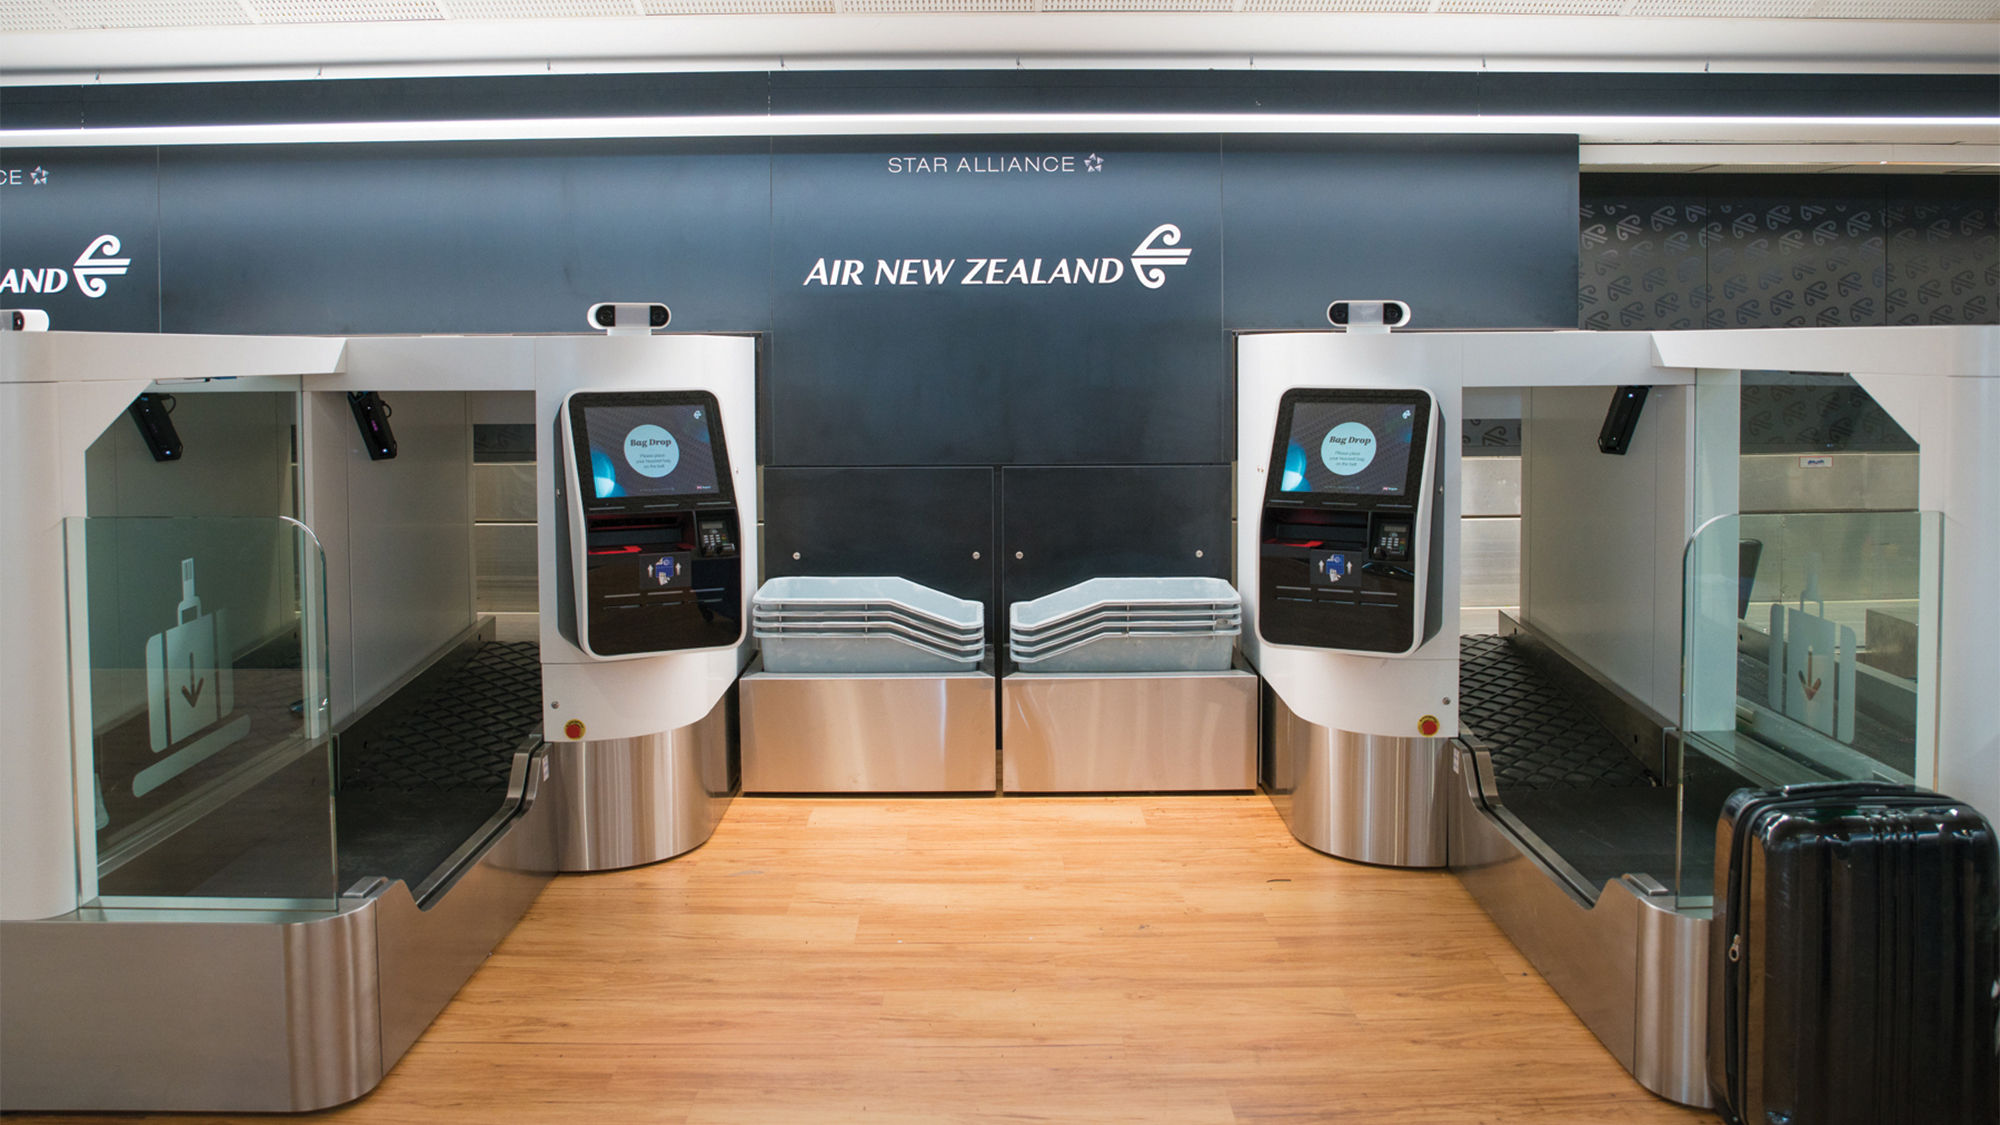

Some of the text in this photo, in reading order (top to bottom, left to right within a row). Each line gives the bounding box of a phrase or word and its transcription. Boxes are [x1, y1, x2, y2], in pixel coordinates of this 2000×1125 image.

[887, 156, 1075, 174] STAR ALLIANCE
[803, 257, 1124, 286] AIR NEW ZEALAND
[0, 268, 69, 294] AND
[630, 438, 672, 448] Bag Drop
[1329, 435, 1372, 446] Bag Drop
